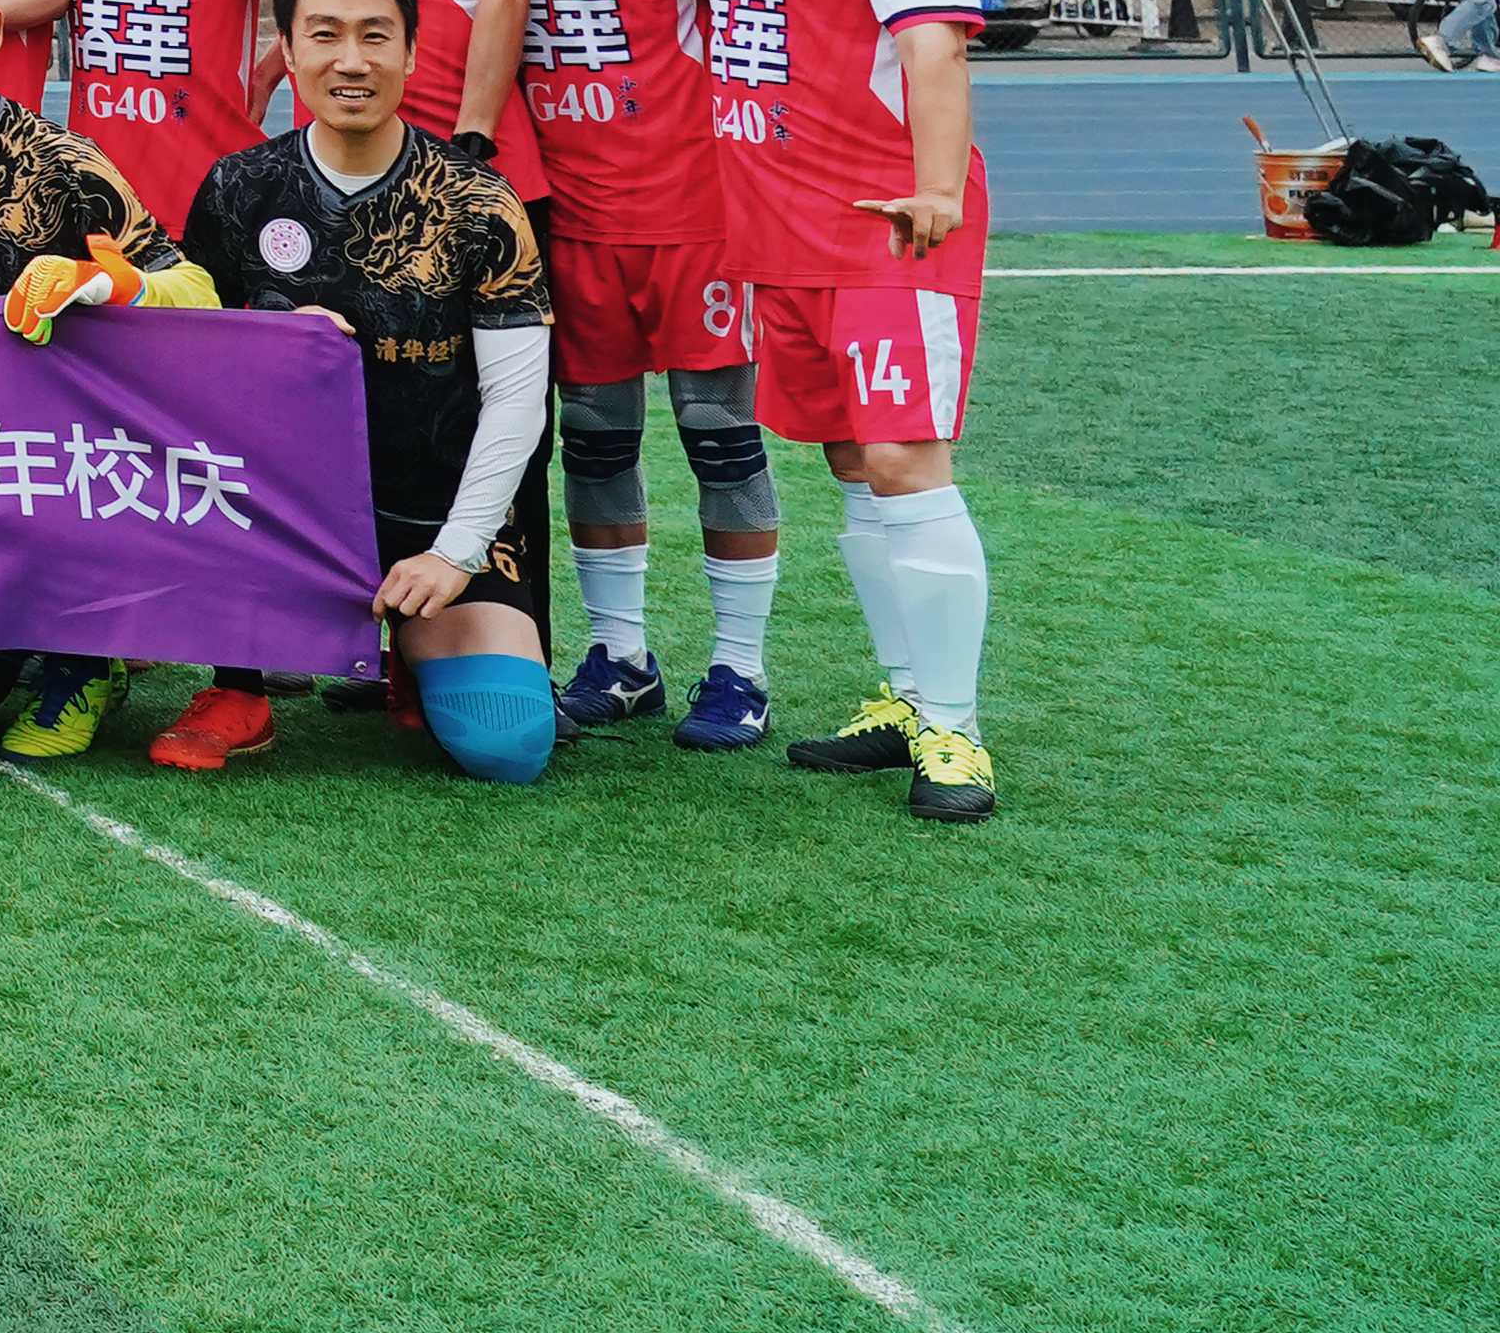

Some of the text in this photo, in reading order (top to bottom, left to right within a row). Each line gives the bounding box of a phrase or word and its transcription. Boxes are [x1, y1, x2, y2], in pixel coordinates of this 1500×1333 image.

[87, 82, 167, 123] G40
[525, 82, 615, 123] G40
[703, 280, 736, 338] 8
[847, 339, 912, 406] 14
